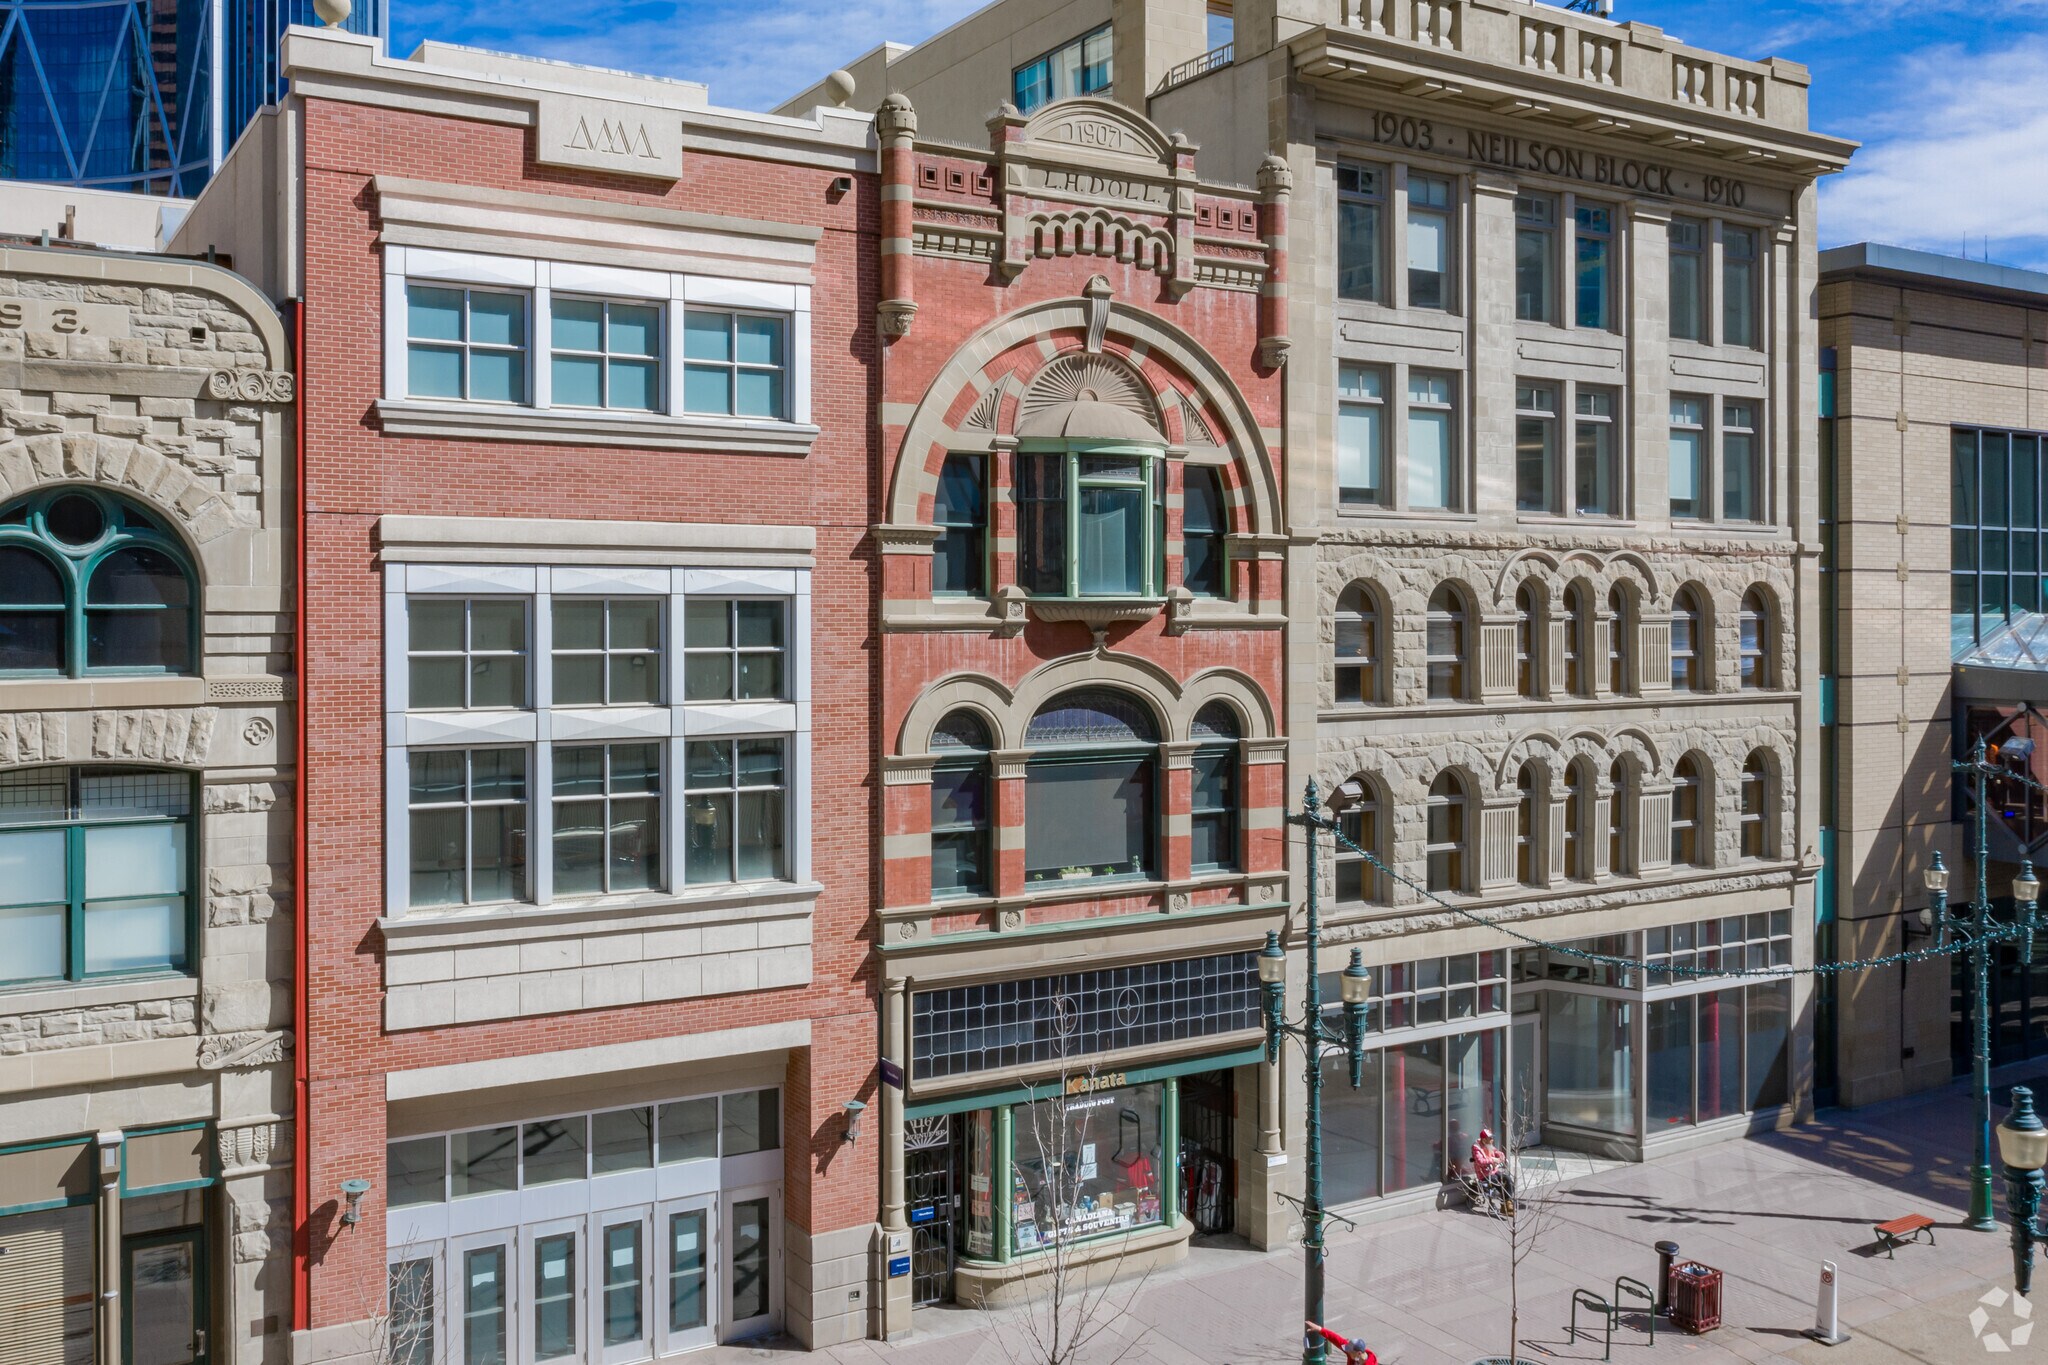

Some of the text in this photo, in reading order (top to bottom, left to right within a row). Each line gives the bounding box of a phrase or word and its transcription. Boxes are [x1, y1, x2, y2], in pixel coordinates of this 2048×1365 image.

[1078, 122, 1117, 148] 1907
[1371, 113, 1746, 208] 1903 NEILSON BLOCK 1910
[1066, 1071, 1127, 1095] Kanata
[1097, 1096, 1115, 1107] POST
[1065, 1208, 1115, 1225] CANADIANA
[1082, 1214, 1130, 1231] SOUVENIRS
